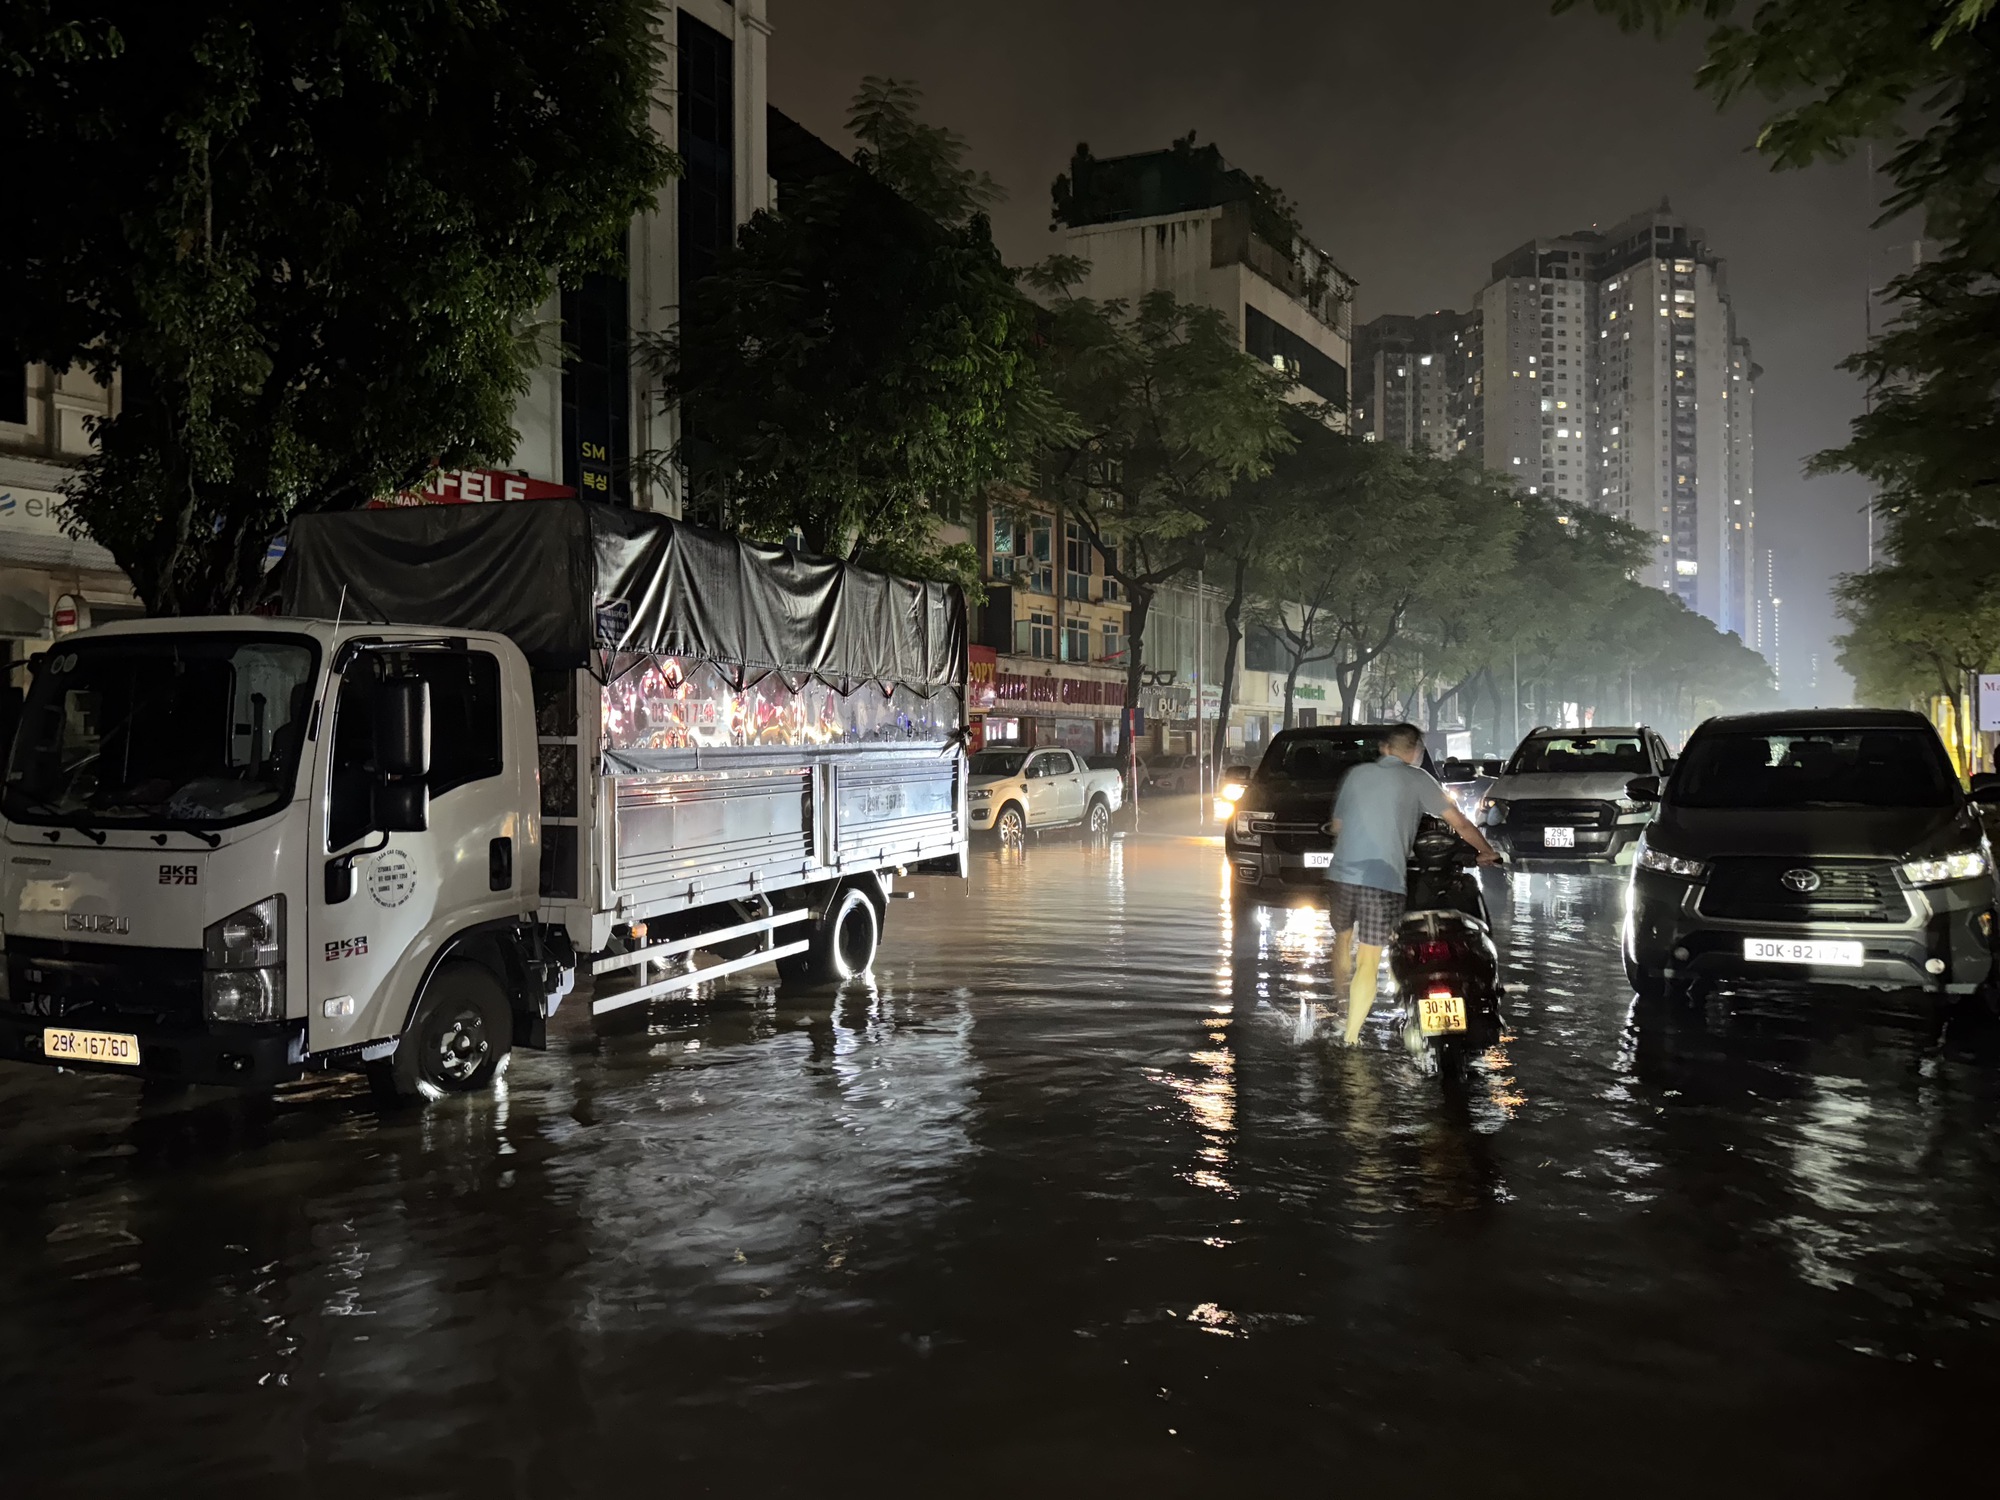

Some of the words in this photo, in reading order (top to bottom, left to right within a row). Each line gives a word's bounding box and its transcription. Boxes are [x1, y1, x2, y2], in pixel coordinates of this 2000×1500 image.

[582, 441, 606, 462] SM
[583, 471, 608, 491] 복싱
[1551, 828, 1568, 838] 29C
[1311, 855, 1330, 865] 30M
[159, 865, 198, 875] QKR
[159, 875, 198, 886] 270
[64, 912, 131, 936] ISUZU
[325, 936, 367, 952] QKR
[325, 945, 368, 962] 270
